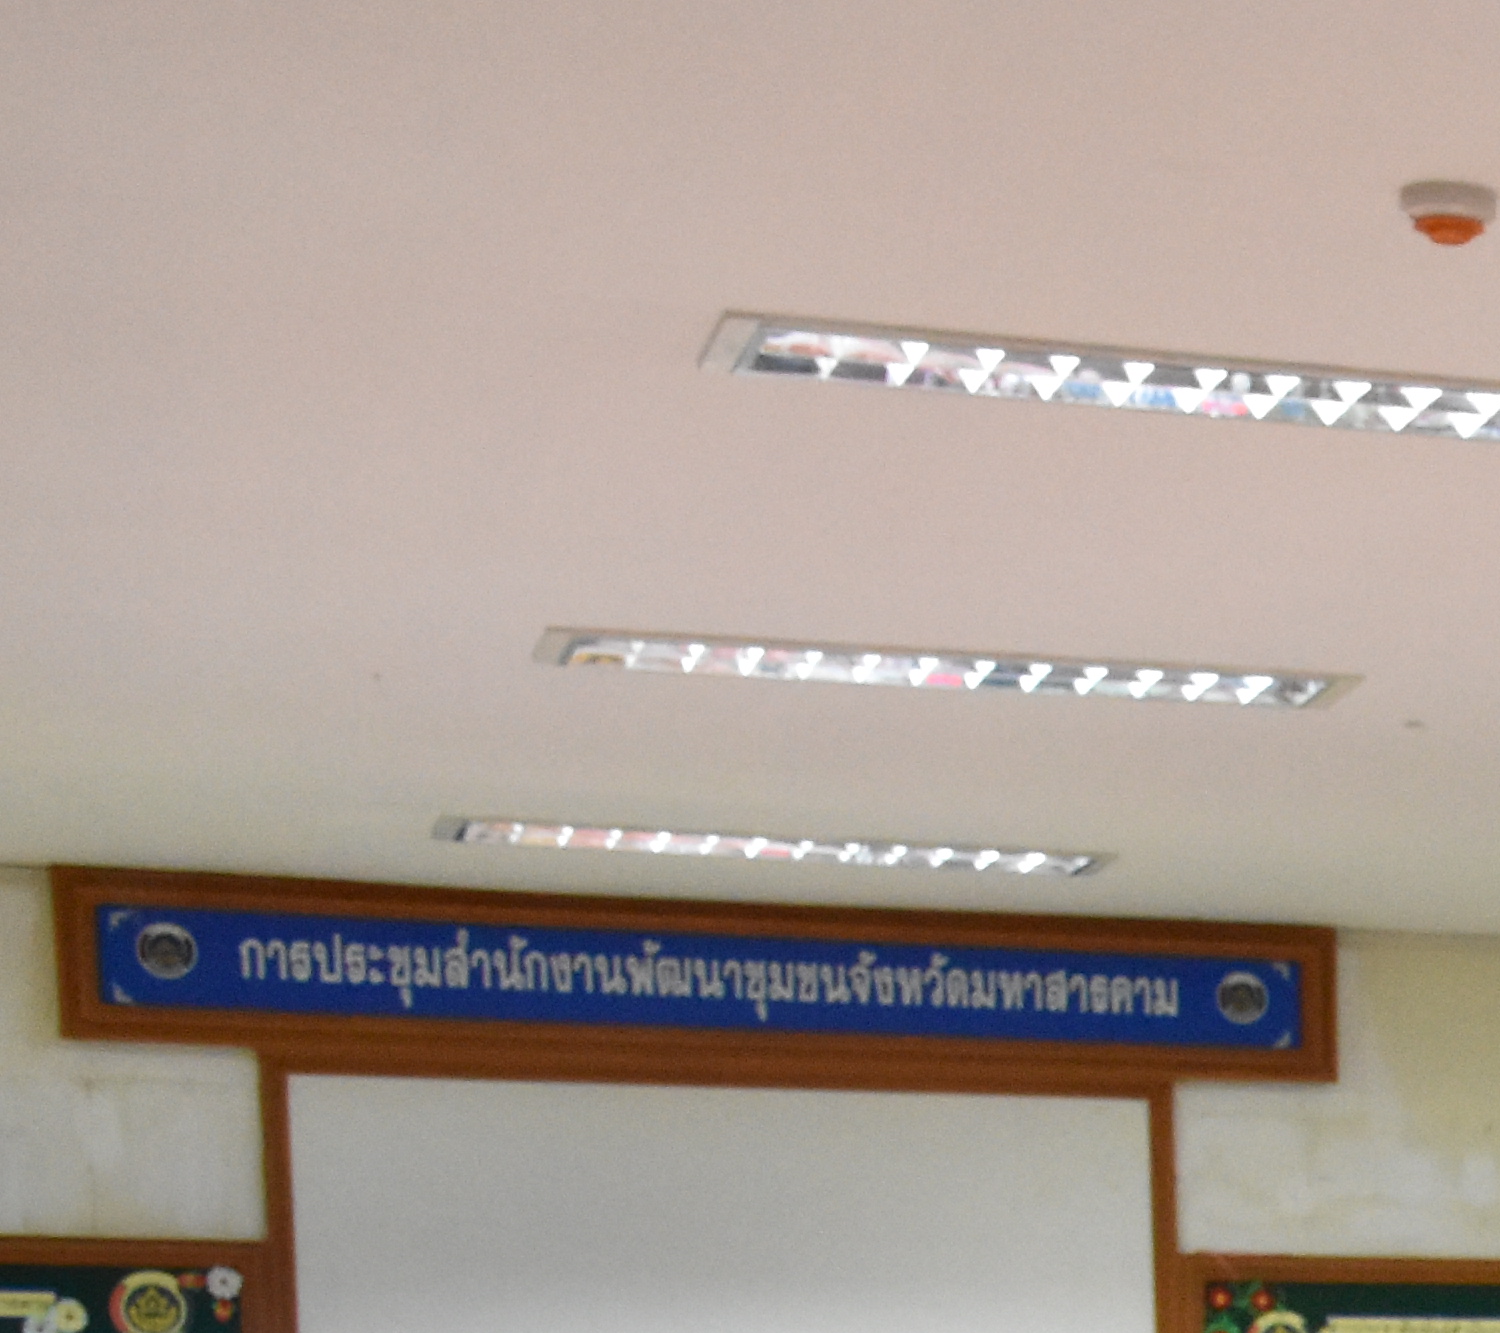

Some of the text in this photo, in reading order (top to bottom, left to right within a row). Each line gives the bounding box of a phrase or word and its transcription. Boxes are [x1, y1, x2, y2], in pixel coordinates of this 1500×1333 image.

[239, 927, 1179, 1022] การประชุมสำนักงานพัฒนาชุมชนจังหวัดมหาสารคาม
